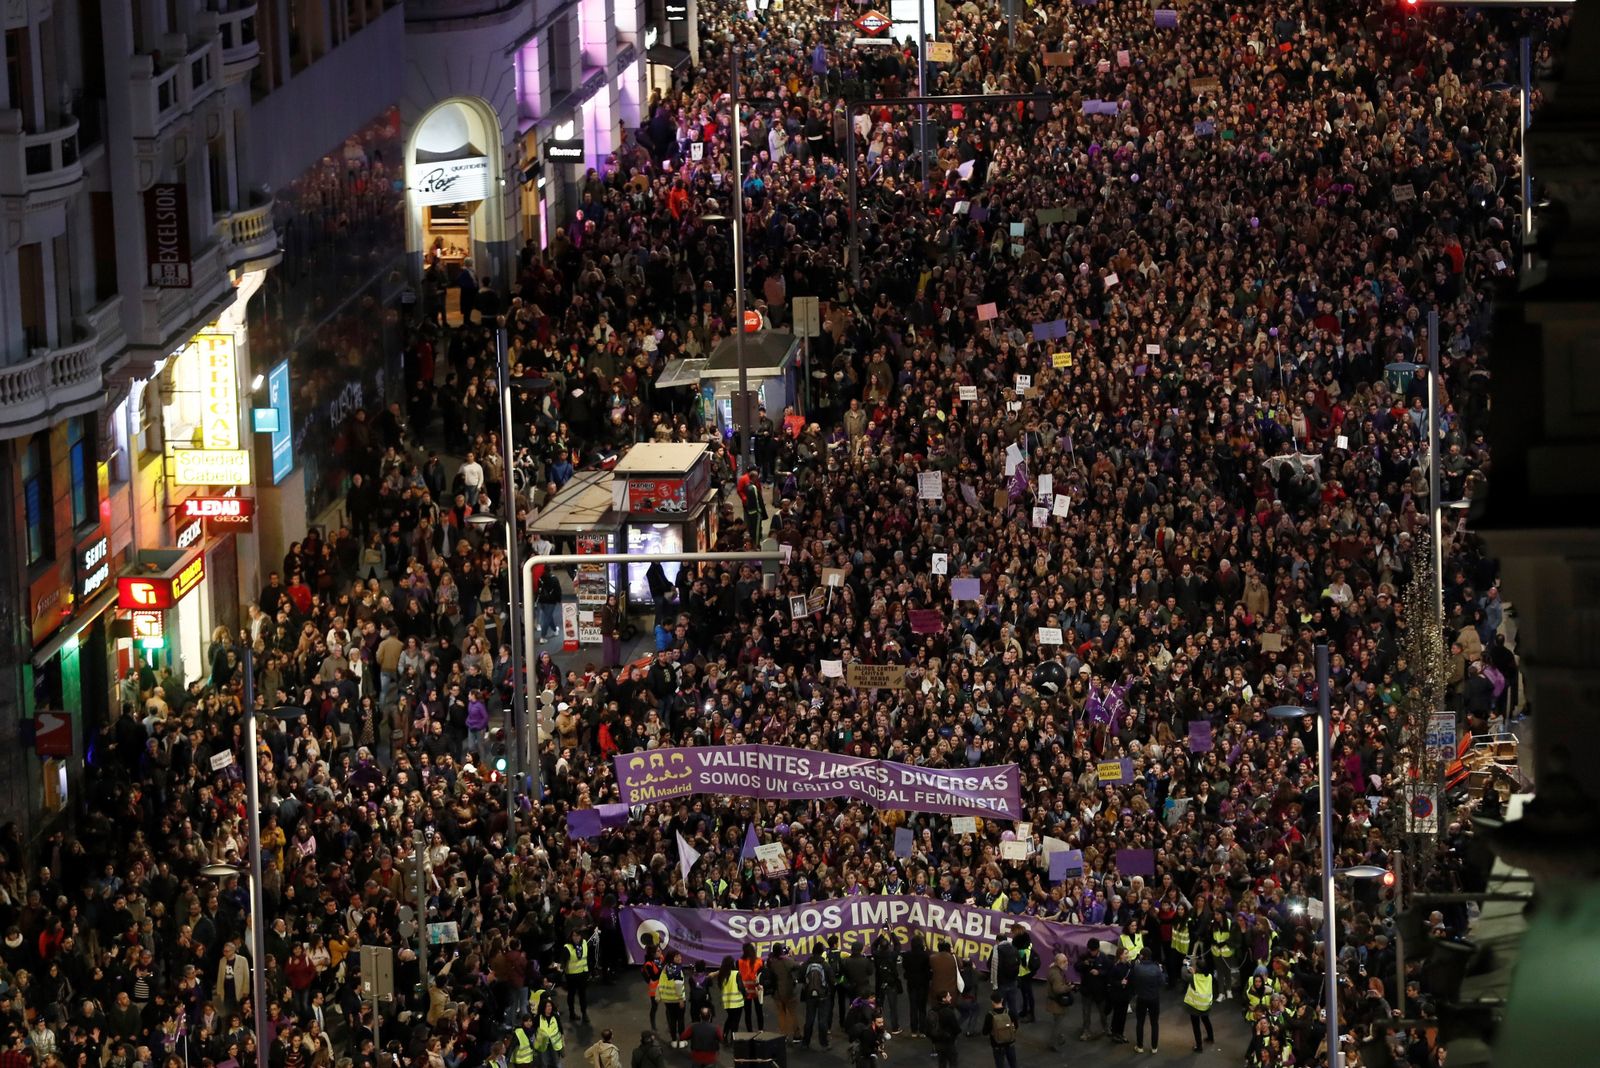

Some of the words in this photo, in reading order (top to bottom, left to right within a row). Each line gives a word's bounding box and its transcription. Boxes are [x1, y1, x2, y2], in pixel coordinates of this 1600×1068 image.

[156, 187, 179, 262] EXCELSIOR
[206, 338, 231, 447] PELUCAS
[180, 452, 244, 465] Soledad
[183, 469, 243, 482] Cabello
[697, 751, 813, 780] VALIENTES,
[818, 761, 895, 787] LIBRES,
[901, 770, 1009, 791] DIVERSAS
[630, 786, 656, 803] 8M
[657, 783, 692, 797] Madrid
[700, 772, 761, 788] SOMOS
[766, 778, 788, 792] UN
[792, 780, 844, 792] GRITO
[848, 779, 910, 803] GLOBAL
[914, 791, 1009, 811] FEMINISTA
[728, 905, 842, 939] SOMOS
